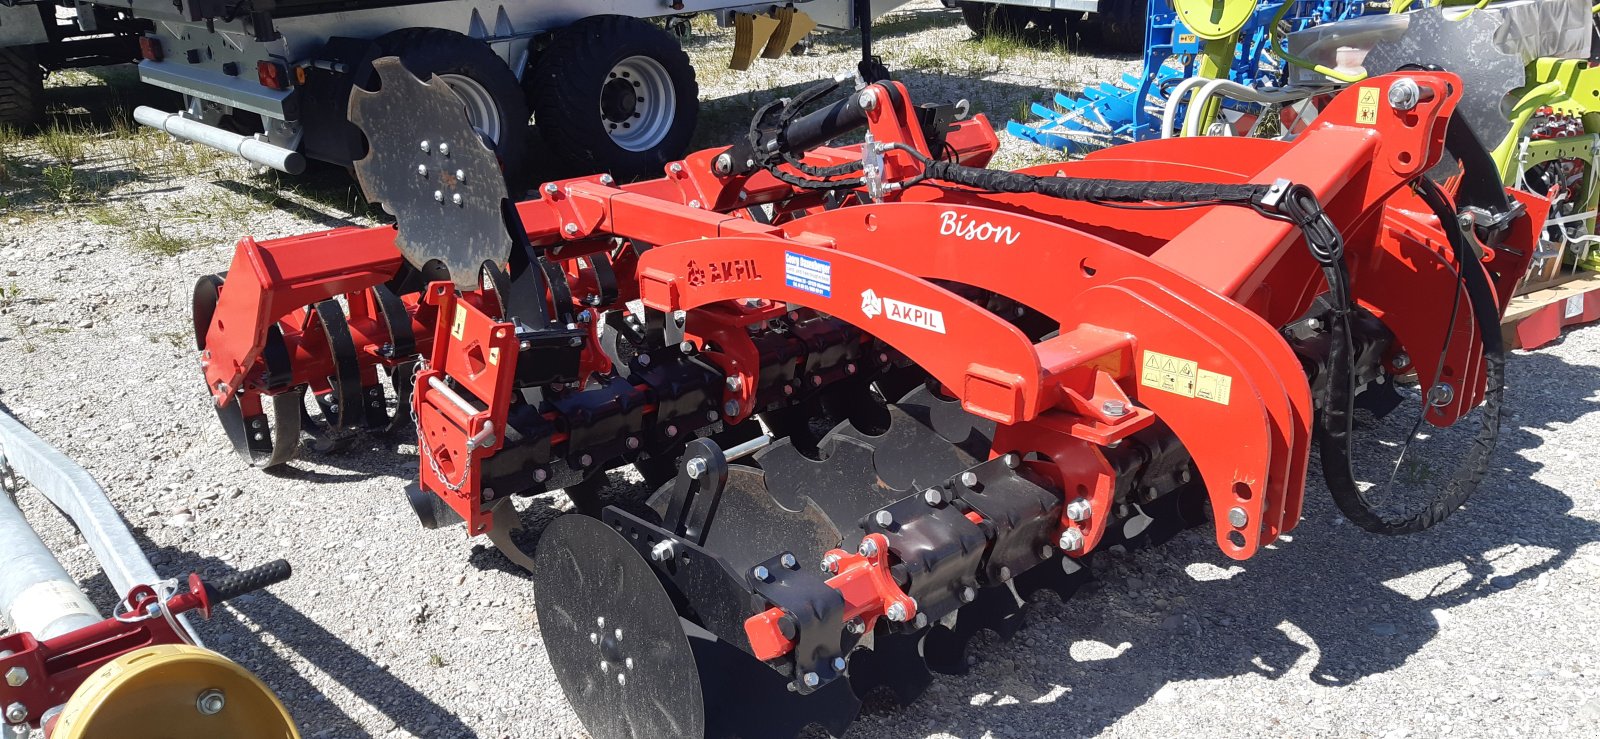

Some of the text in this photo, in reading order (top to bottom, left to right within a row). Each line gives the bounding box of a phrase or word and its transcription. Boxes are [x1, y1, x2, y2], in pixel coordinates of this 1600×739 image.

[940, 210, 1021, 245] Bison
[708, 259, 762, 283] AKPIL
[891, 303, 937, 328] AKPIL
